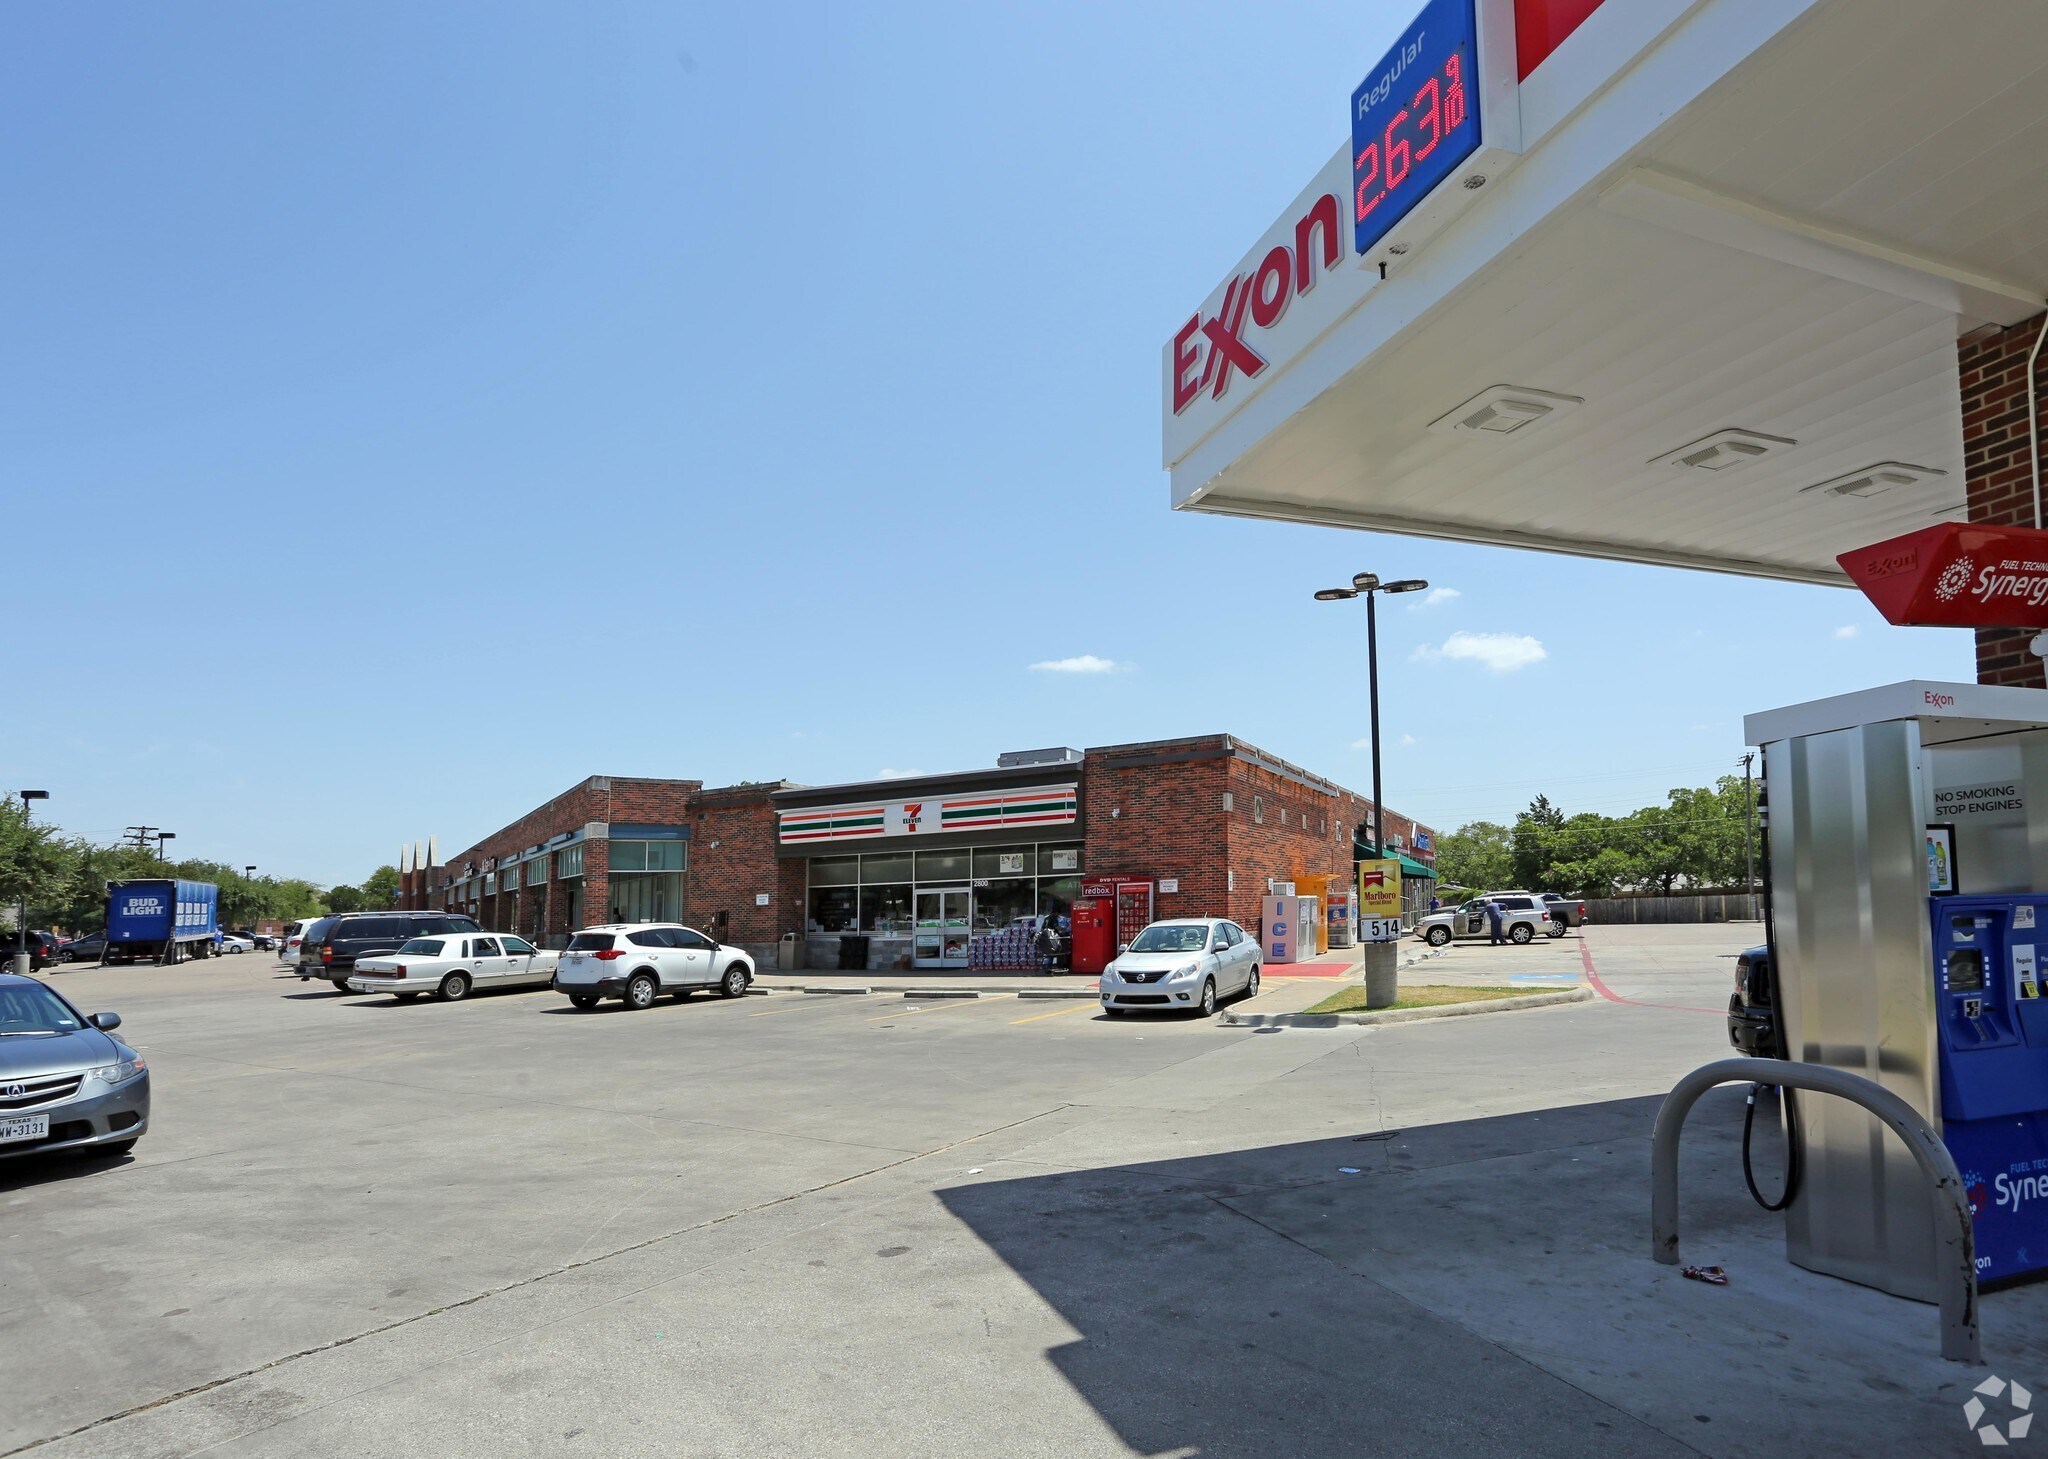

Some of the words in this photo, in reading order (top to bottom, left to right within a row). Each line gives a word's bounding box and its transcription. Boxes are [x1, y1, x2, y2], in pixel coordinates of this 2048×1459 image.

[1358, 31, 1425, 121] Regular
[1356, 77, 1440, 222] 2.63
[1173, 193, 1344, 417] Exxon
[1867, 553, 1916, 575] Exxon
[1999, 560, 2019, 570] FUEL
[1971, 566, 2048, 606] Synerg
[1924, 690, 1954, 709] Exxon
[1935, 792, 1953, 803] NO
[1956, 785, 2015, 801] SMOKING
[1935, 804, 1966, 816] STOP
[1968, 799, 2023, 813] ENGINES
[904, 803, 922, 832] 7
[1085, 887, 1110, 895] redbox
[1364, 891, 1396, 900] Marlboro
[122, 906, 163, 916] LIGHT
[129, 898, 158, 907] BUD
[1272, 902, 1287, 956] ICE
[2010, 1162, 2030, 1174] FUEL
